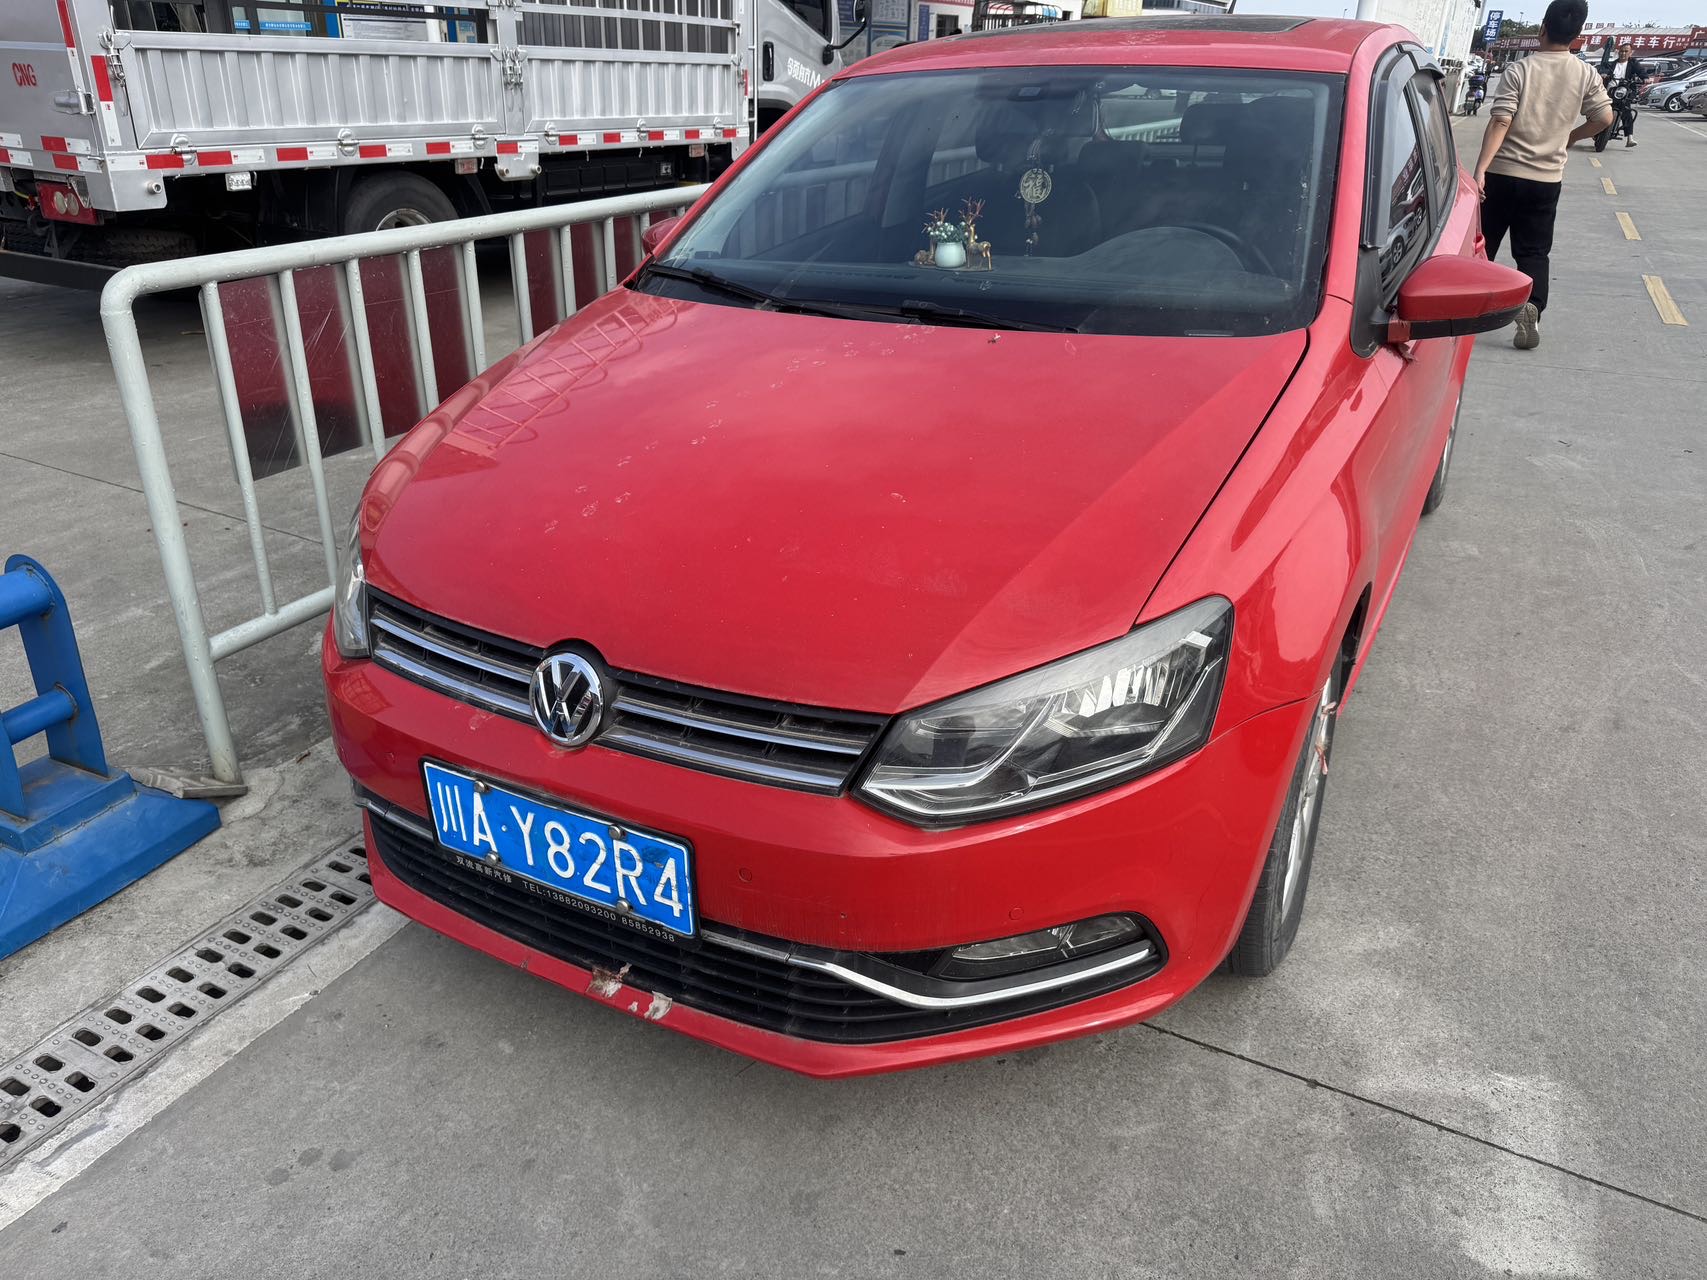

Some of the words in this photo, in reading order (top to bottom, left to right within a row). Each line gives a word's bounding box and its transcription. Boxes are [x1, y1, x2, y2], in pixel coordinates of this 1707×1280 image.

[1485, 12, 1501, 37] 停车场
[12, 62, 38, 87] CNG
[787, 57, 826, 89] 领航M
[622, 916, 676, 943] 85852938
